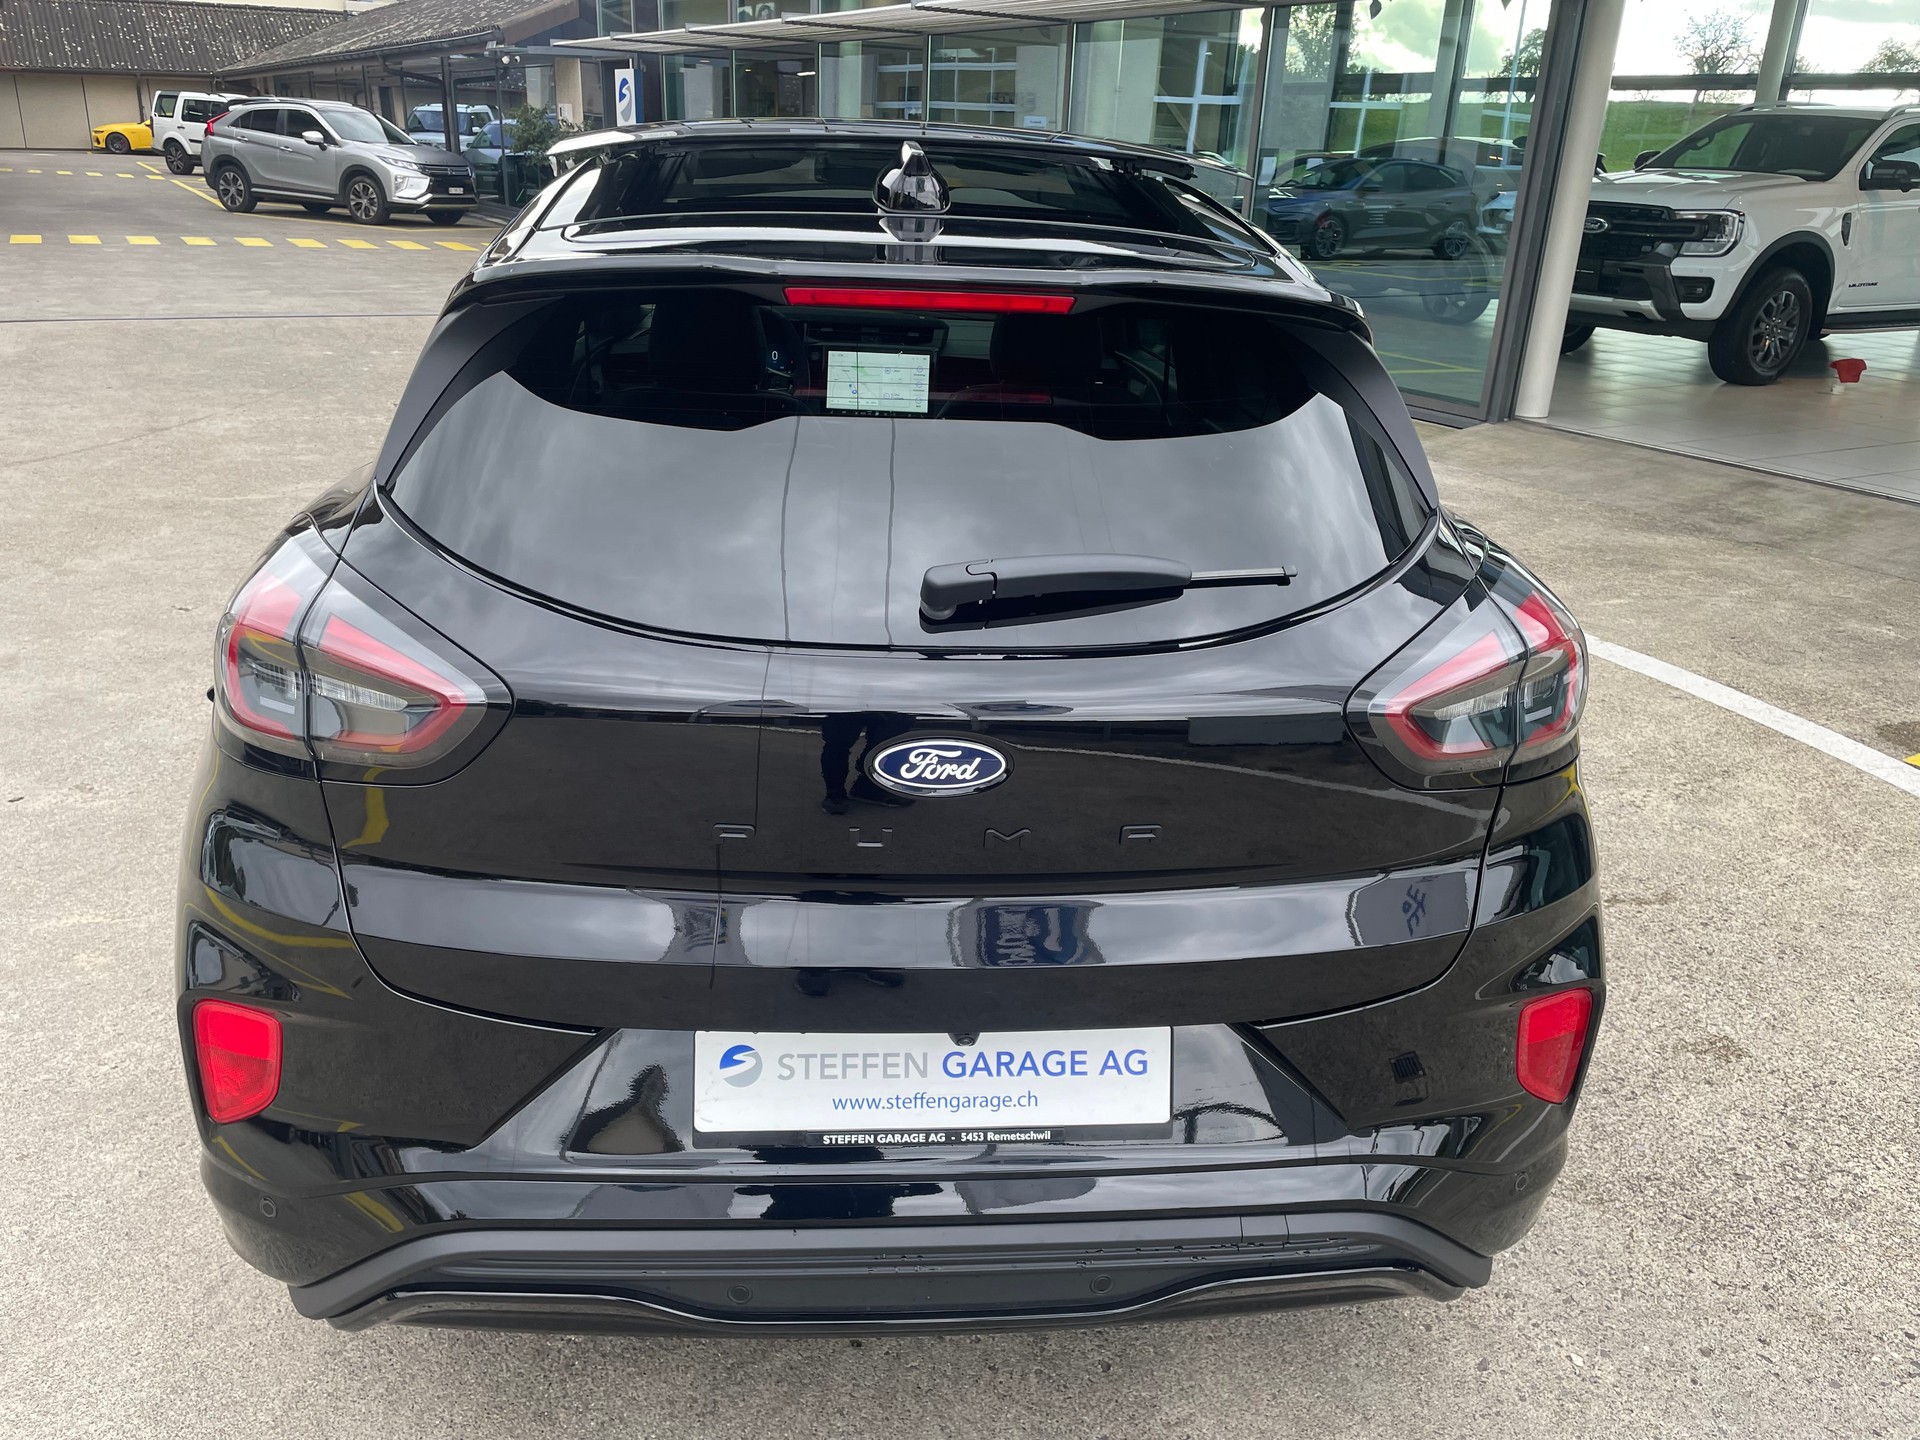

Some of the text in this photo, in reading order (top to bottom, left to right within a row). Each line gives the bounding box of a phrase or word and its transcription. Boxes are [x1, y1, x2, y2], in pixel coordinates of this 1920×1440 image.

[771, 350, 778, 361] 0
[900, 748, 981, 780] Ford
[712, 823, 1163, 849] PUMA
[777, 1049, 1148, 1081] STEFFEN GARAGE AG
[832, 1090, 1039, 1113] www.steffengarage.ch
[822, 1134, 874, 1145] STEFFEN
[876, 1133, 926, 1143] GARAGE
[928, 1132, 946, 1143] AG
[960, 1132, 984, 1142] 5453
[987, 1130, 1051, 1142] Remetschwil
